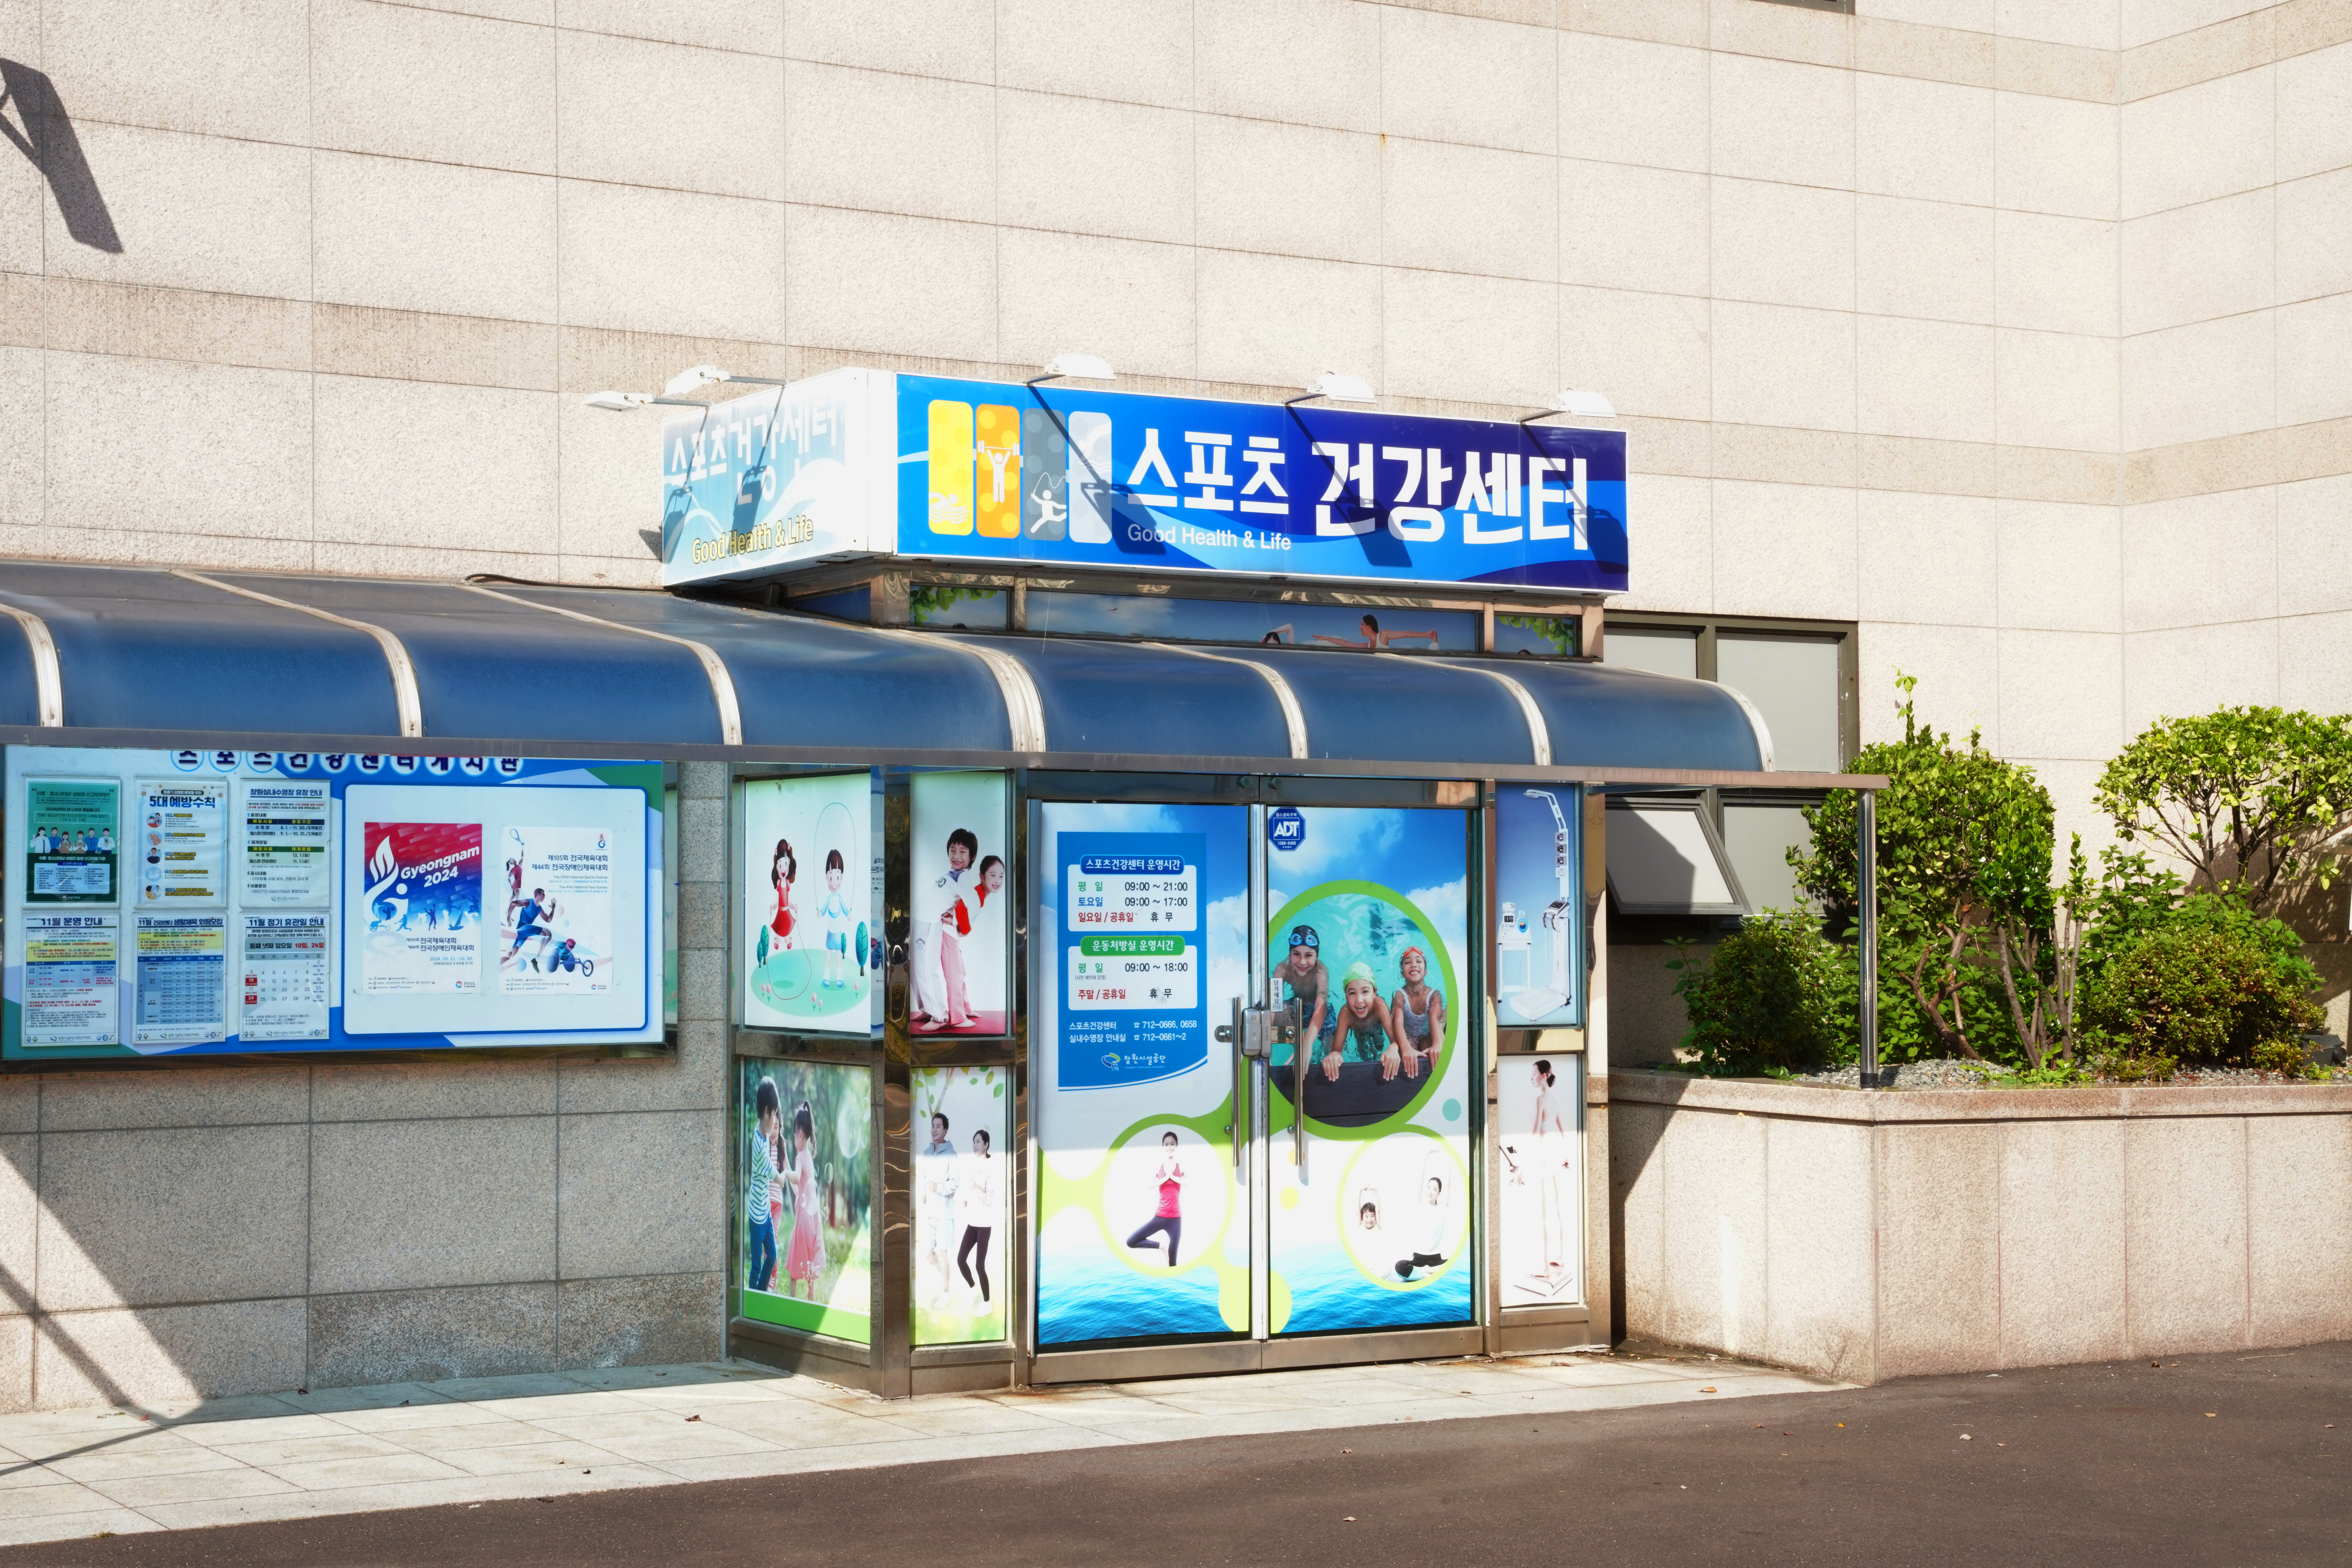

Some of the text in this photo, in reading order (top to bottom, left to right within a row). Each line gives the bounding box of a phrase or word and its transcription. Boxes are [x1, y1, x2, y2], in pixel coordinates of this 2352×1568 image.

[1127, 428, 1588, 550] 스포츠 건강센터
[692, 515, 813, 564] Good Health & Life
[1127, 523, 1291, 551] Good Health & Life
[149, 796, 216, 808] 5대 예방수칙
[1274, 821, 1299, 837] ADT
[401, 846, 480, 879] Gyeongnam
[1086, 859, 1181, 871] 스포츠건강센터 운영시간
[424, 866, 459, 888] 2024
[1125, 882, 1150, 891] 09:00
[1163, 882, 1188, 891] 21:00
[1078, 897, 1103, 907] 토요일
[1125, 897, 1150, 906] 09:00
[1164, 897, 1188, 906] 17:00
[84, 917, 102, 926] 안내
[1078, 912, 1102, 922] 일요일
[1110, 912, 1134, 922] 공휴일
[1092, 940, 1174, 951] 운동처방실 운영시간
[1125, 963, 1150, 972] 09:00
[1164, 963, 1188, 972] 18:00
[1078, 989, 1094, 1000] 주말
[1102, 989, 1126, 999] 공휴일
[1069, 1021, 1117, 1030] 스포츠건강센터
[1142, 1020, 1178, 1029] 712-0666,
[1069, 1033, 1186, 1043] 실내수영장 안내실 712-0661~2
[1124, 1053, 1166, 1065] 창원시설공단
